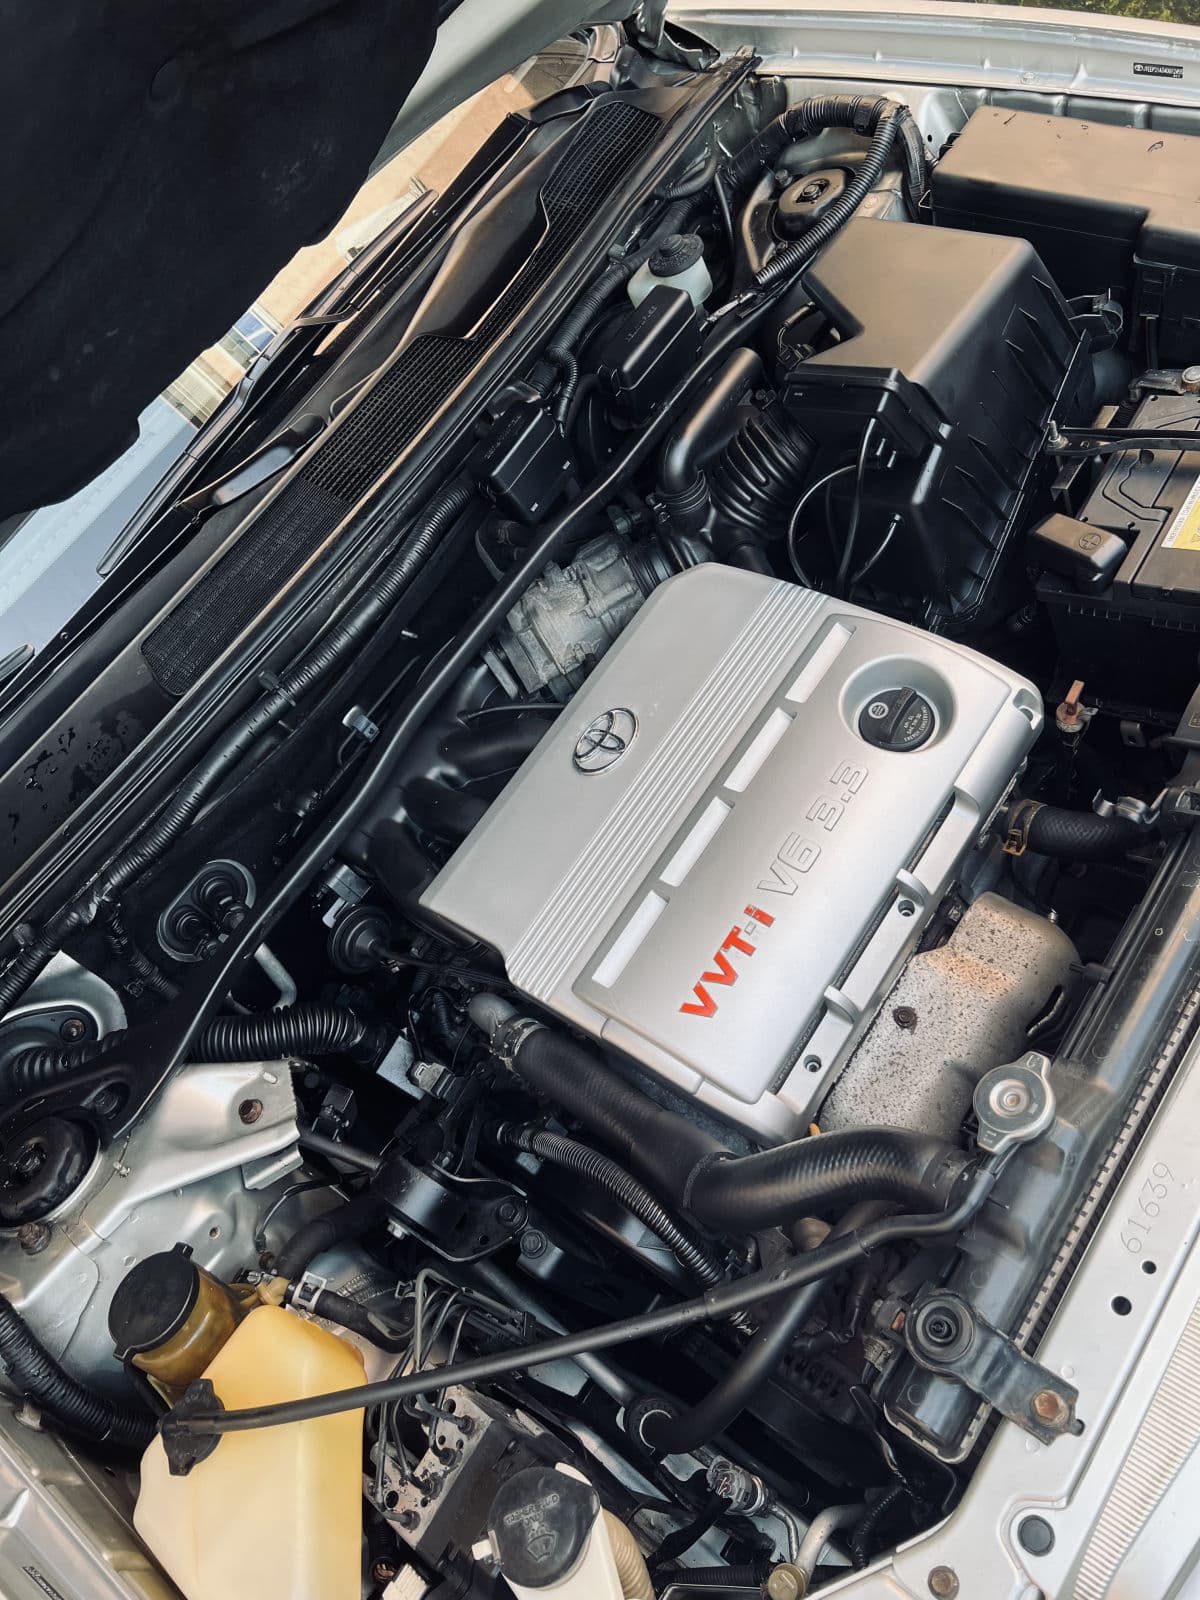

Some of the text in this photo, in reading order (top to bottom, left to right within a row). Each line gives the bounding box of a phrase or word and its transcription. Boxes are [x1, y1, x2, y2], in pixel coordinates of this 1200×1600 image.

[757, 832, 822, 896] V6
[805, 759, 869, 832] 3.3
[1120, 1162, 1175, 1254] 61639
